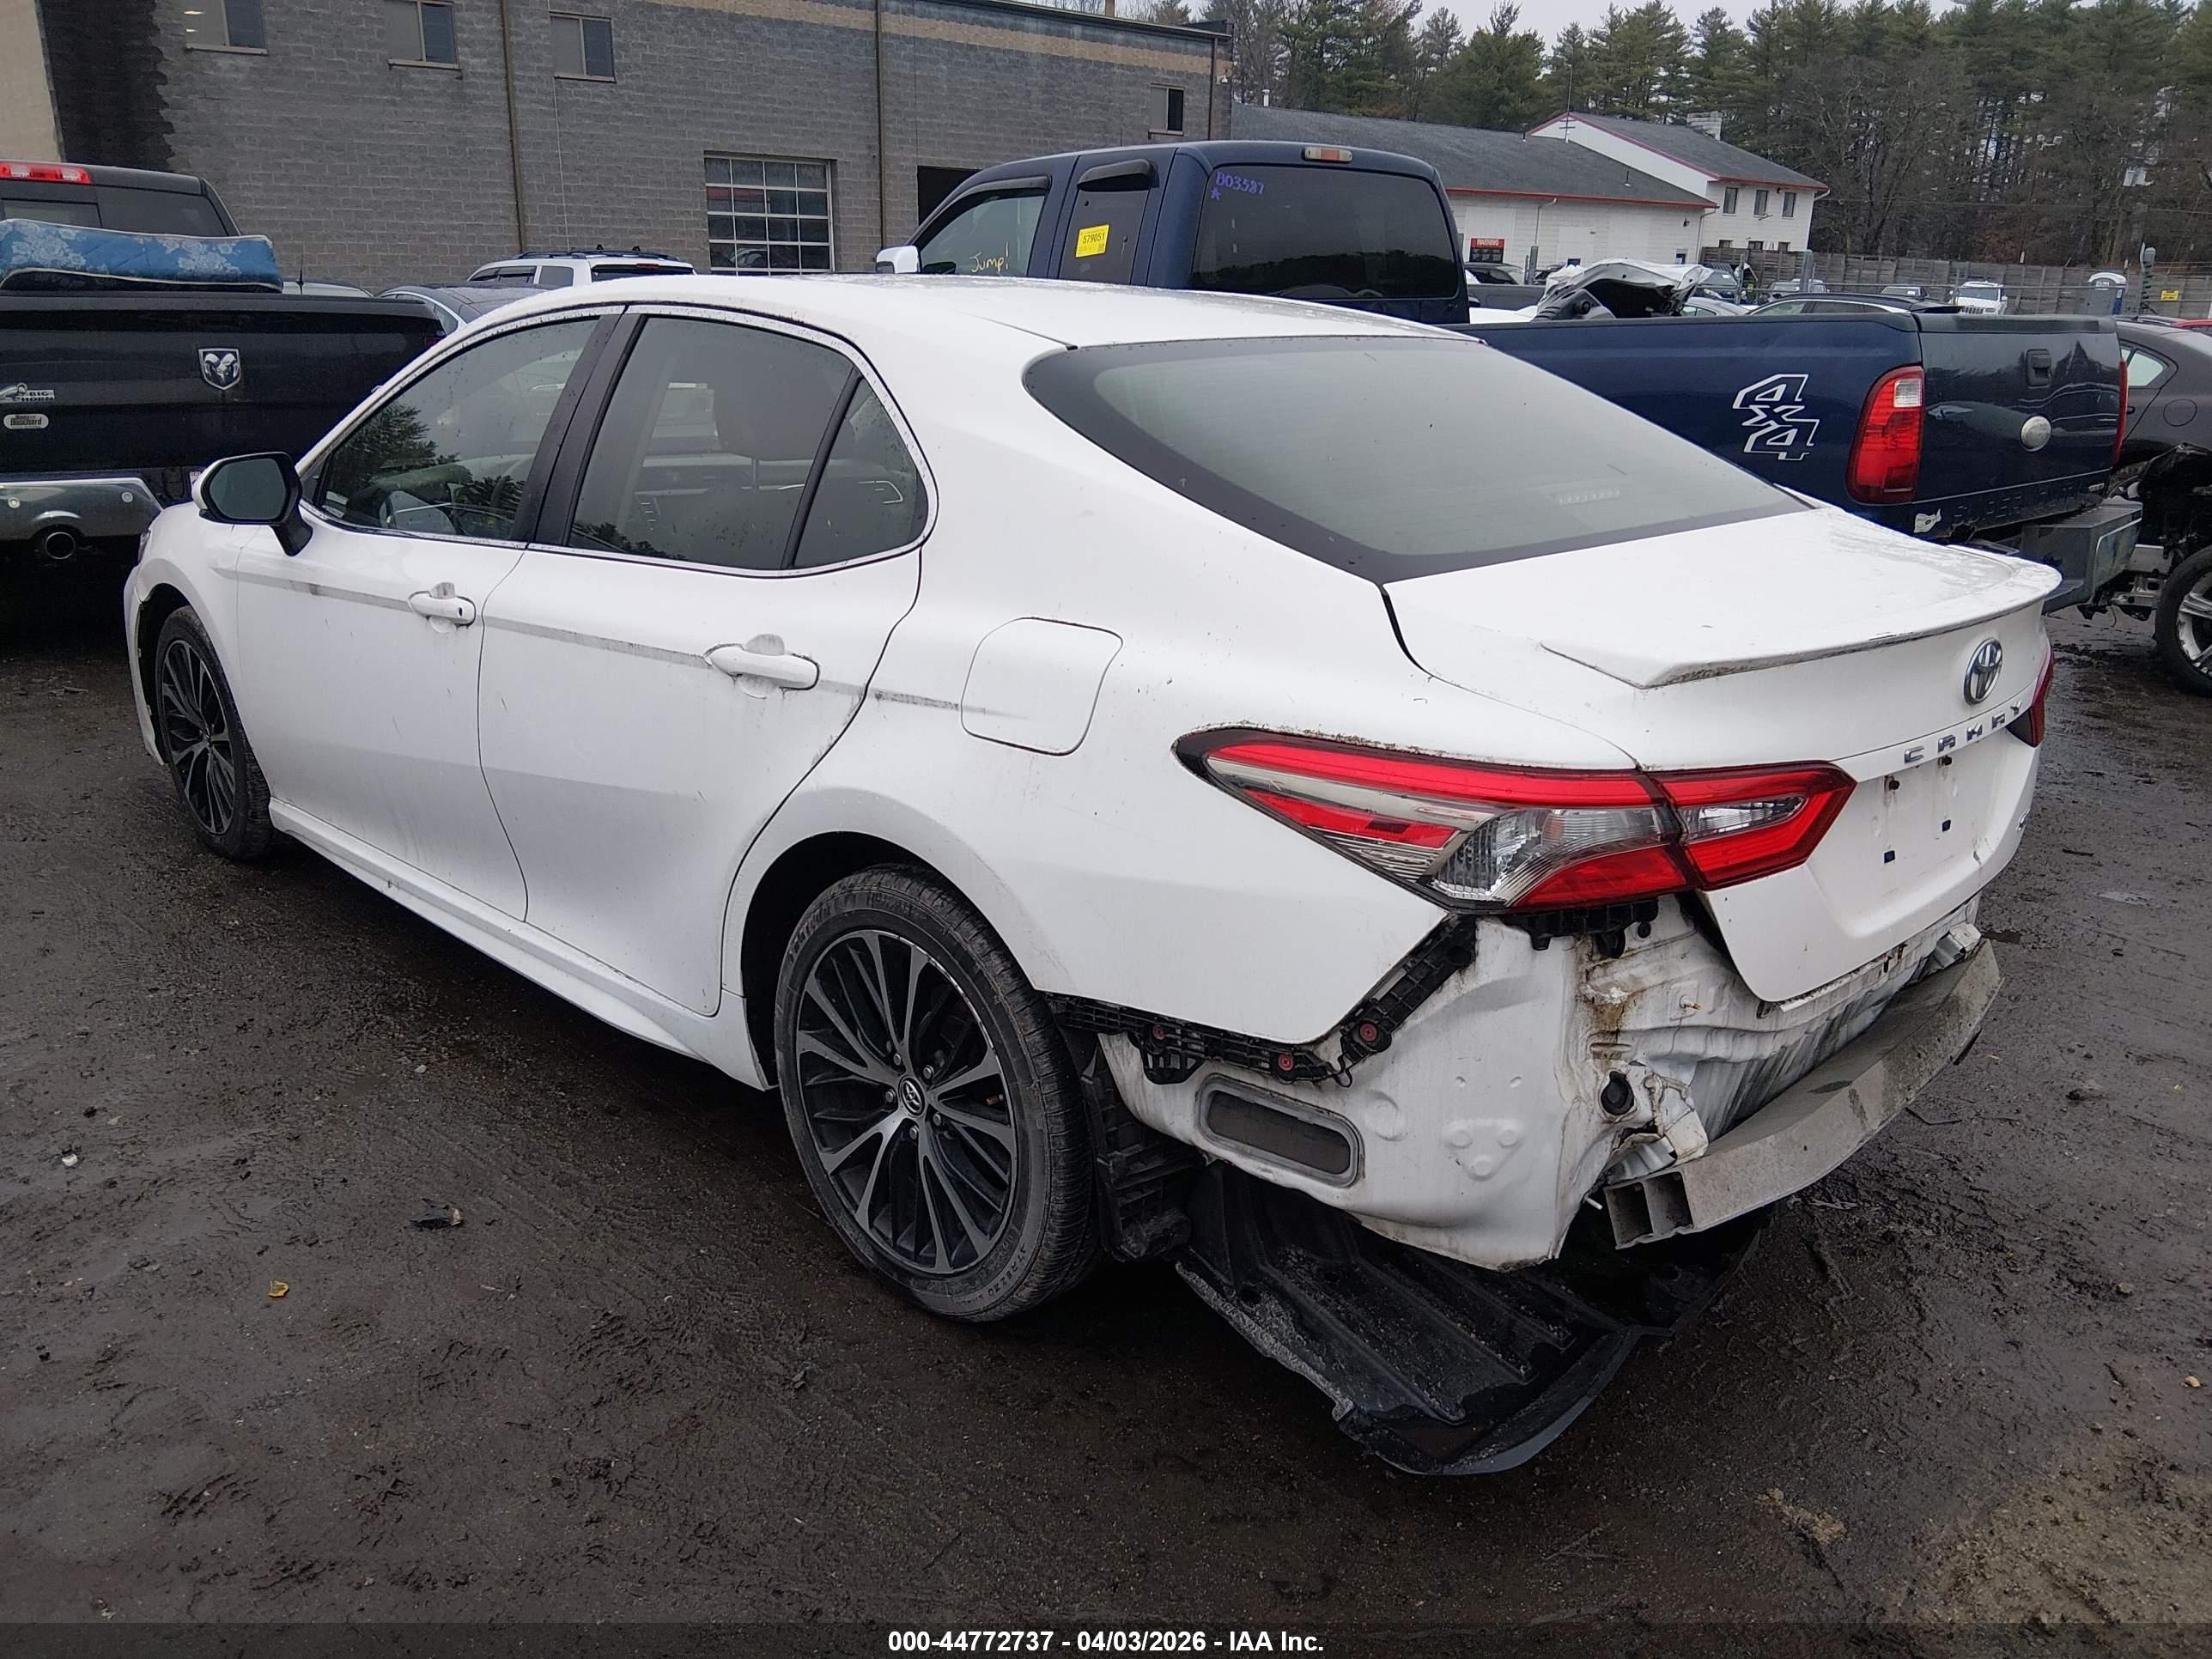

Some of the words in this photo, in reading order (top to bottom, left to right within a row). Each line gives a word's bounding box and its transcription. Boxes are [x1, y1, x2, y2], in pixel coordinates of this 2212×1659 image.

[1215, 171, 1265, 195] B03587
[969, 241, 1009, 276] Jump!
[1904, 701, 2022, 763] CAMRY
